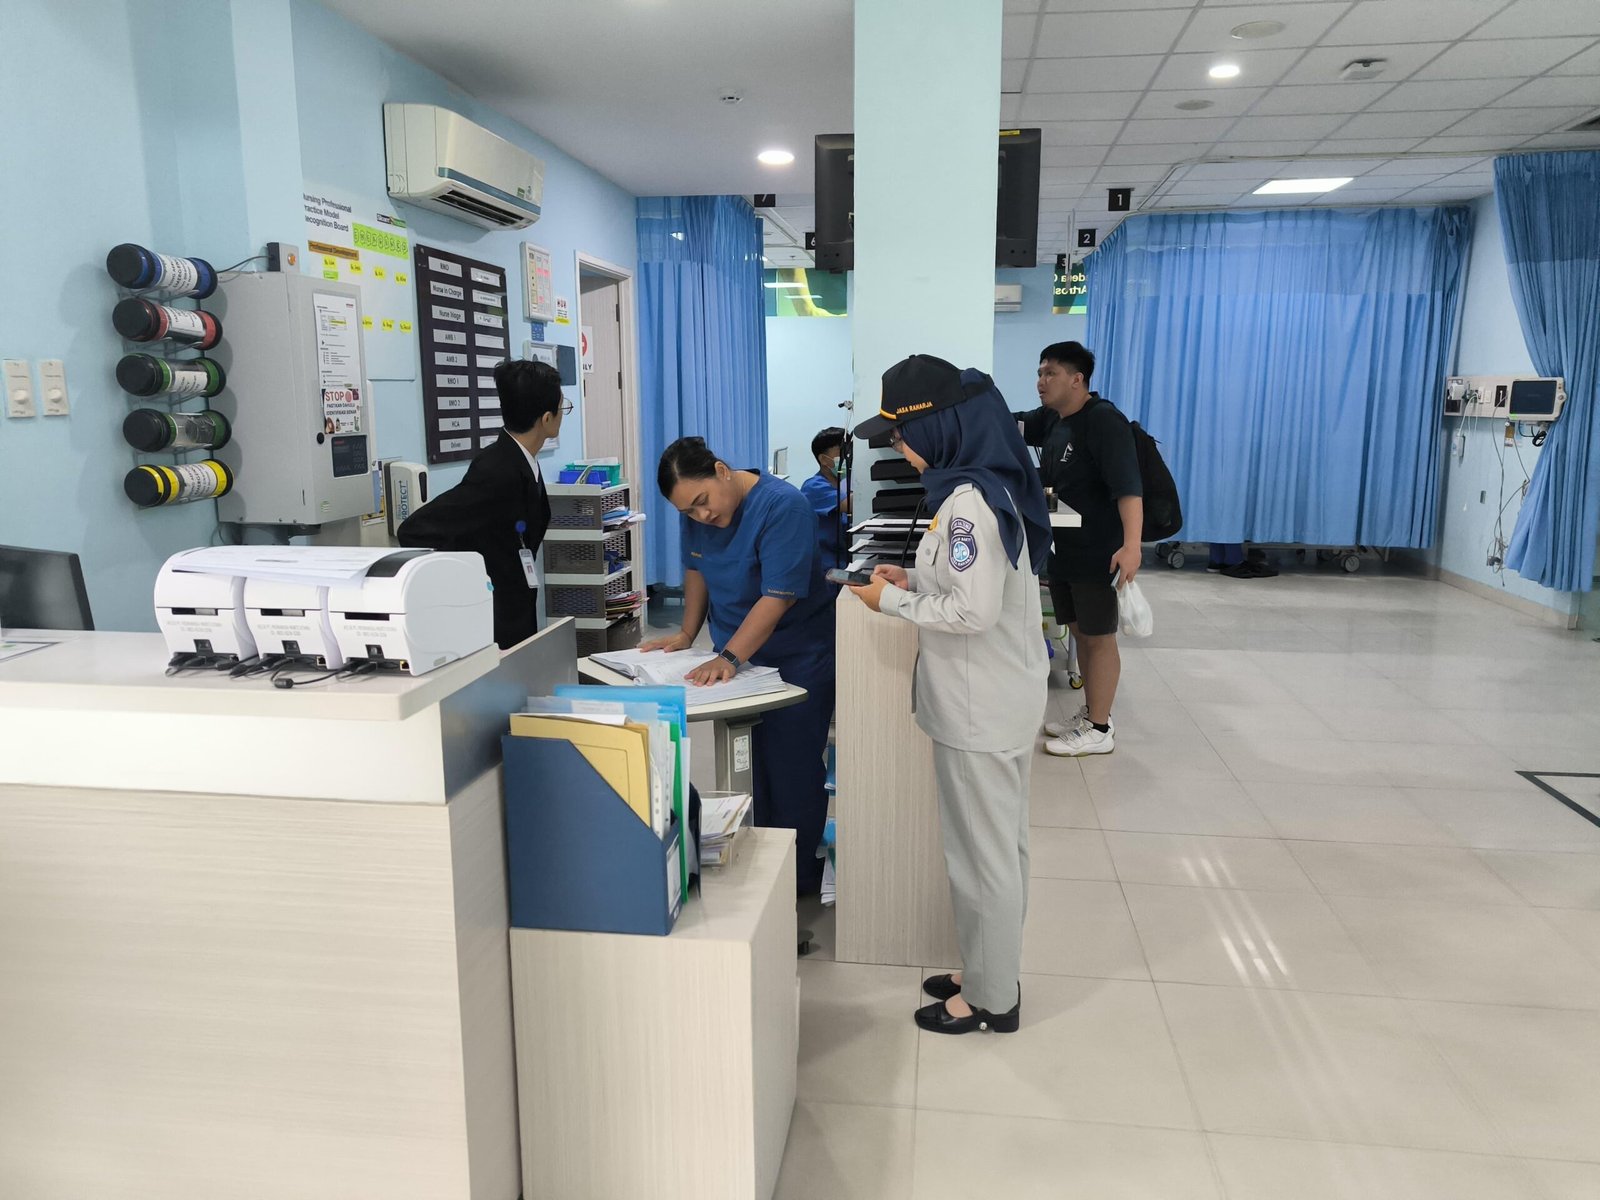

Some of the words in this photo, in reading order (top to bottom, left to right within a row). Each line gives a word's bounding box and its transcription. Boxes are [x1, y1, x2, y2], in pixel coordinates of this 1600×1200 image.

[322, 198, 352, 213] Professional
[1117, 194, 1123, 206] 1
[304, 205, 323, 216] ractice
[323, 208, 340, 219] Model
[334, 221, 349, 232] Board
[810, 237, 816, 246] 6
[1083, 234, 1090, 244] 2
[1062, 258, 1067, 266] 3
[432, 284, 444, 294] Nurse
[448, 288, 462, 298] Charge
[450, 311, 462, 320] Triage
[326, 392, 344, 402] STOP
[896, 406, 908, 414] JASA
[909, 402, 933, 412] RAHARJA
